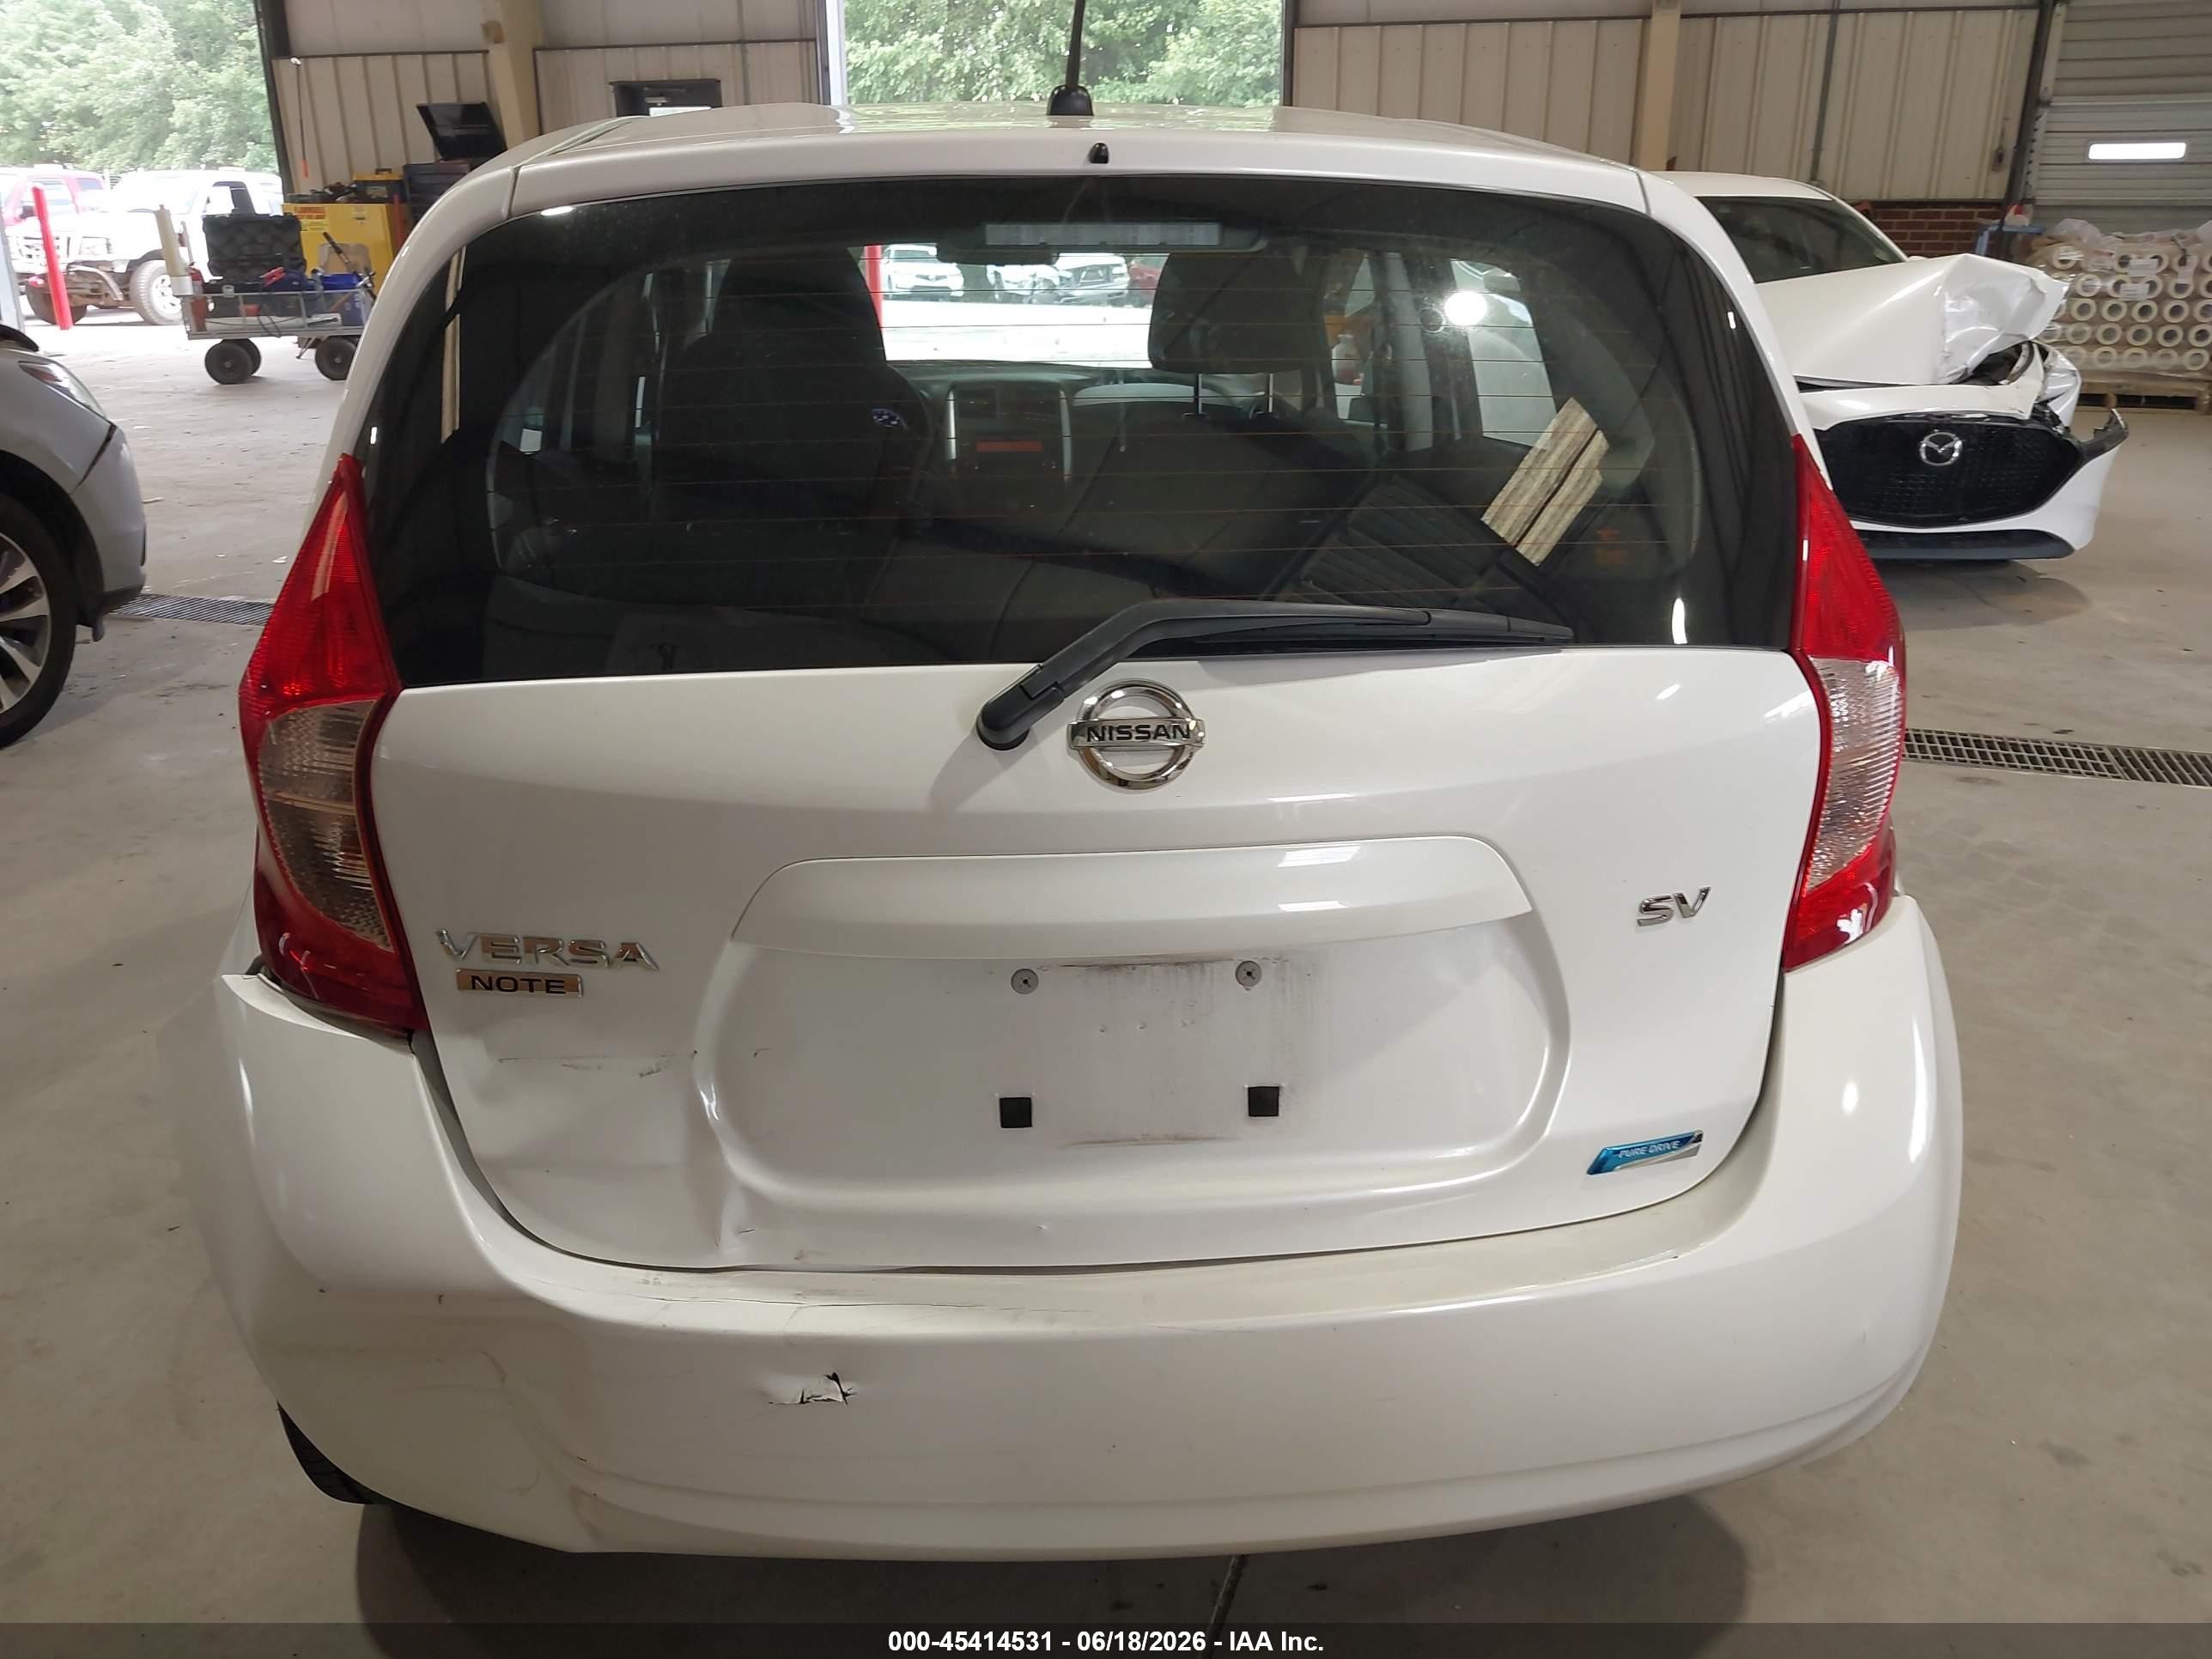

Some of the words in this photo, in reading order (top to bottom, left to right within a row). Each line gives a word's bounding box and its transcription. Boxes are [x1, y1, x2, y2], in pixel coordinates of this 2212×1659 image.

[1086, 724, 1191, 743] NISSAN
[1637, 886, 1711, 927] SV
[435, 928, 659, 972] VERSA
[471, 975, 567, 994] NOTE
[1619, 1146, 1648, 1158] PURE
[1648, 1140, 1681, 1153] DRIVE
